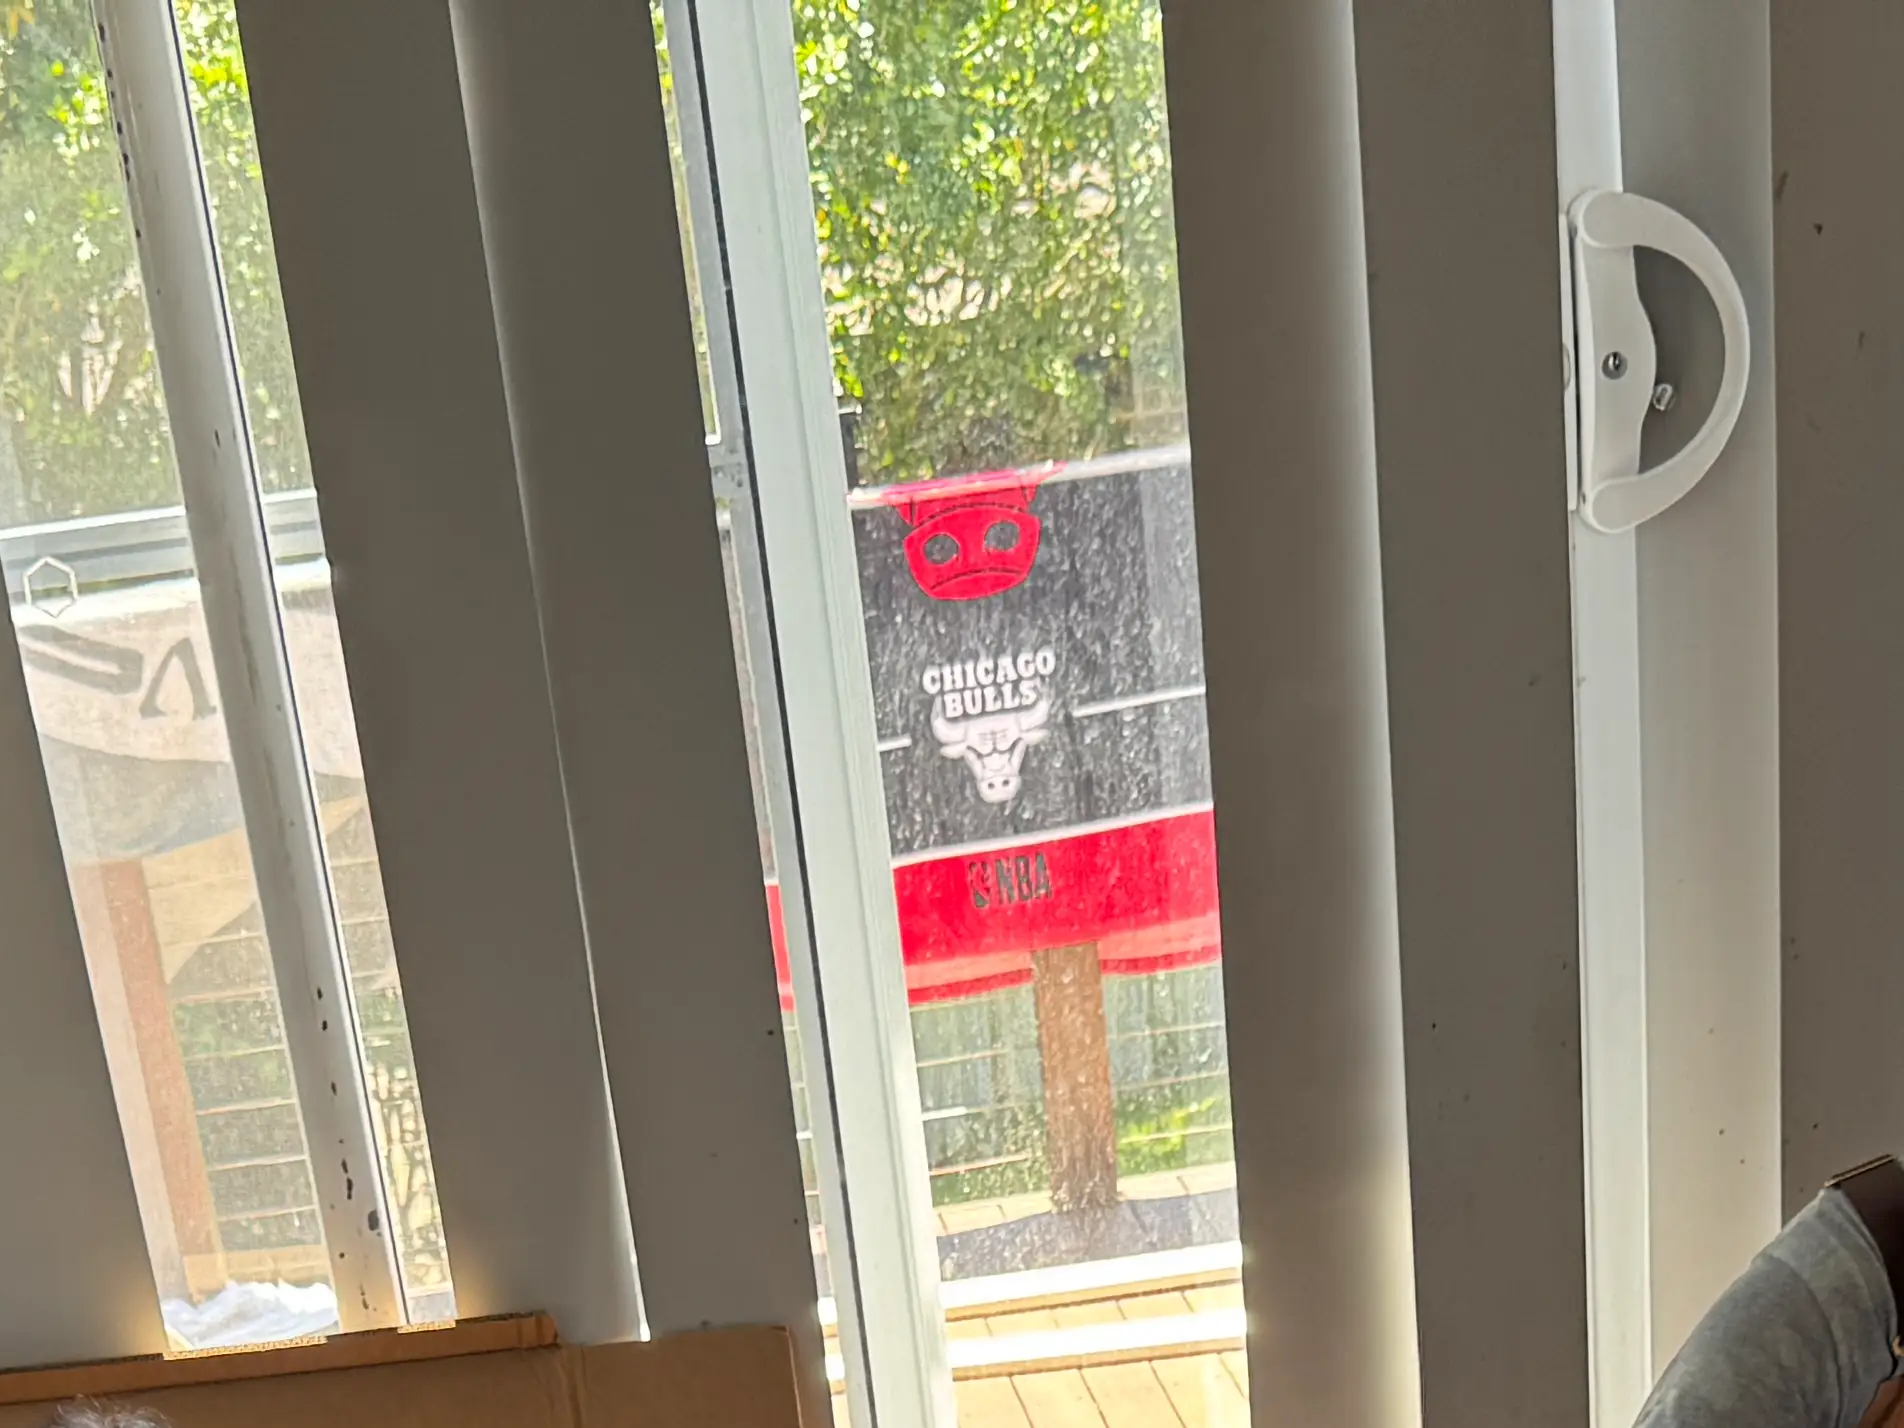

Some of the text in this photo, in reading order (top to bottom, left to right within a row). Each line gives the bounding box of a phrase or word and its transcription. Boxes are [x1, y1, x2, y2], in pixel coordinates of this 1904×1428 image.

[922, 647, 1057, 694] CHICAGO
[943, 680, 1039, 719] BULLS
[995, 852, 1052, 904] NBA
